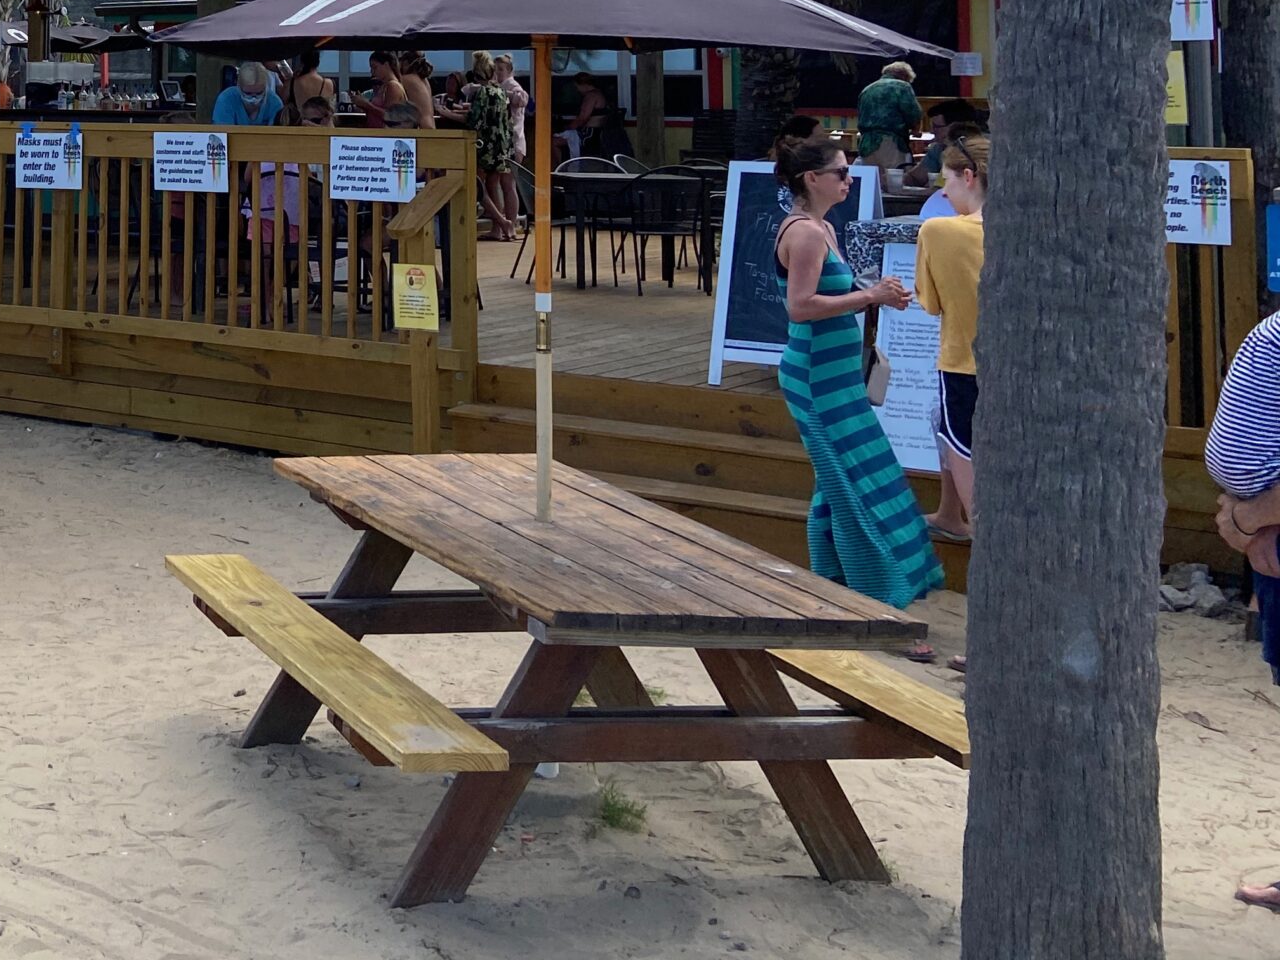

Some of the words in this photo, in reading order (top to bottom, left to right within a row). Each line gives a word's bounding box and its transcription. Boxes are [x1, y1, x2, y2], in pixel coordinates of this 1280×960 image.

[18, 137, 41, 146] Masks
[43, 138, 62, 146] must
[20, 149, 29, 158] be
[52, 150, 59, 158] to
[392, 149, 414, 158] North
[356, 155, 385, 163] distancing
[22, 162, 42, 170] enter
[44, 162, 56, 170] the
[24, 174, 55, 185] building.
[1191, 174, 1226, 186] North
[1191, 186, 1226, 194] Beach
